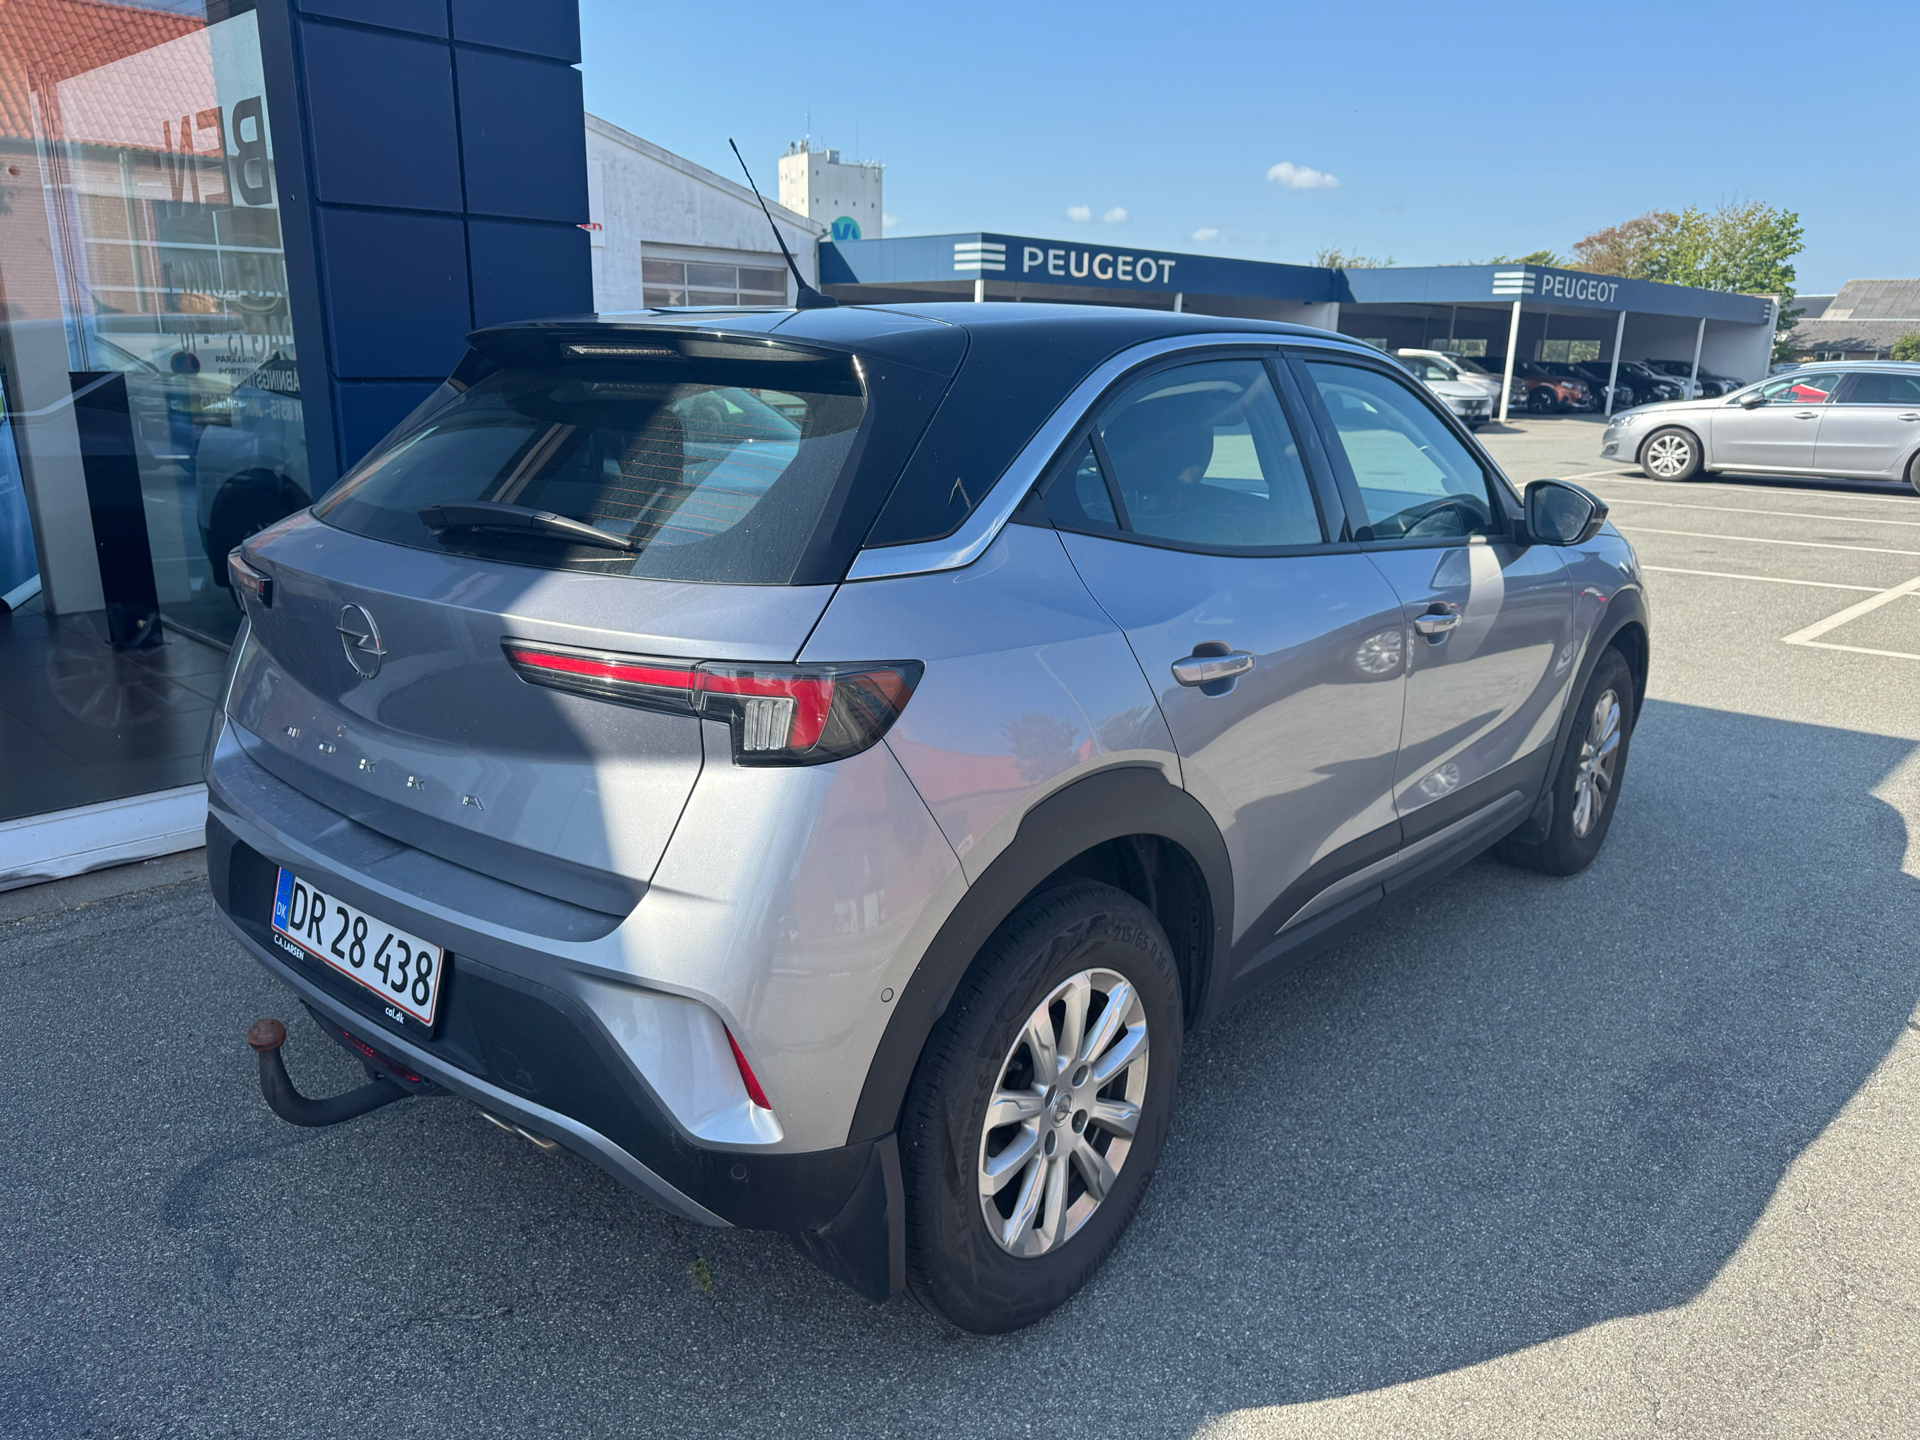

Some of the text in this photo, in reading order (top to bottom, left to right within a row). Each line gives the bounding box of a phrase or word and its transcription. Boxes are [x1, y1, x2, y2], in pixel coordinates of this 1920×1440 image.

[1022, 246, 1176, 284] PEUGEOT
[1541, 274, 1619, 303] PEUGEOT
[276, 901, 286, 919] DK
[289, 881, 433, 1006] DR 28 438
[1112, 924, 1150, 951] 215/65
[1155, 951, 1167, 972] 16
